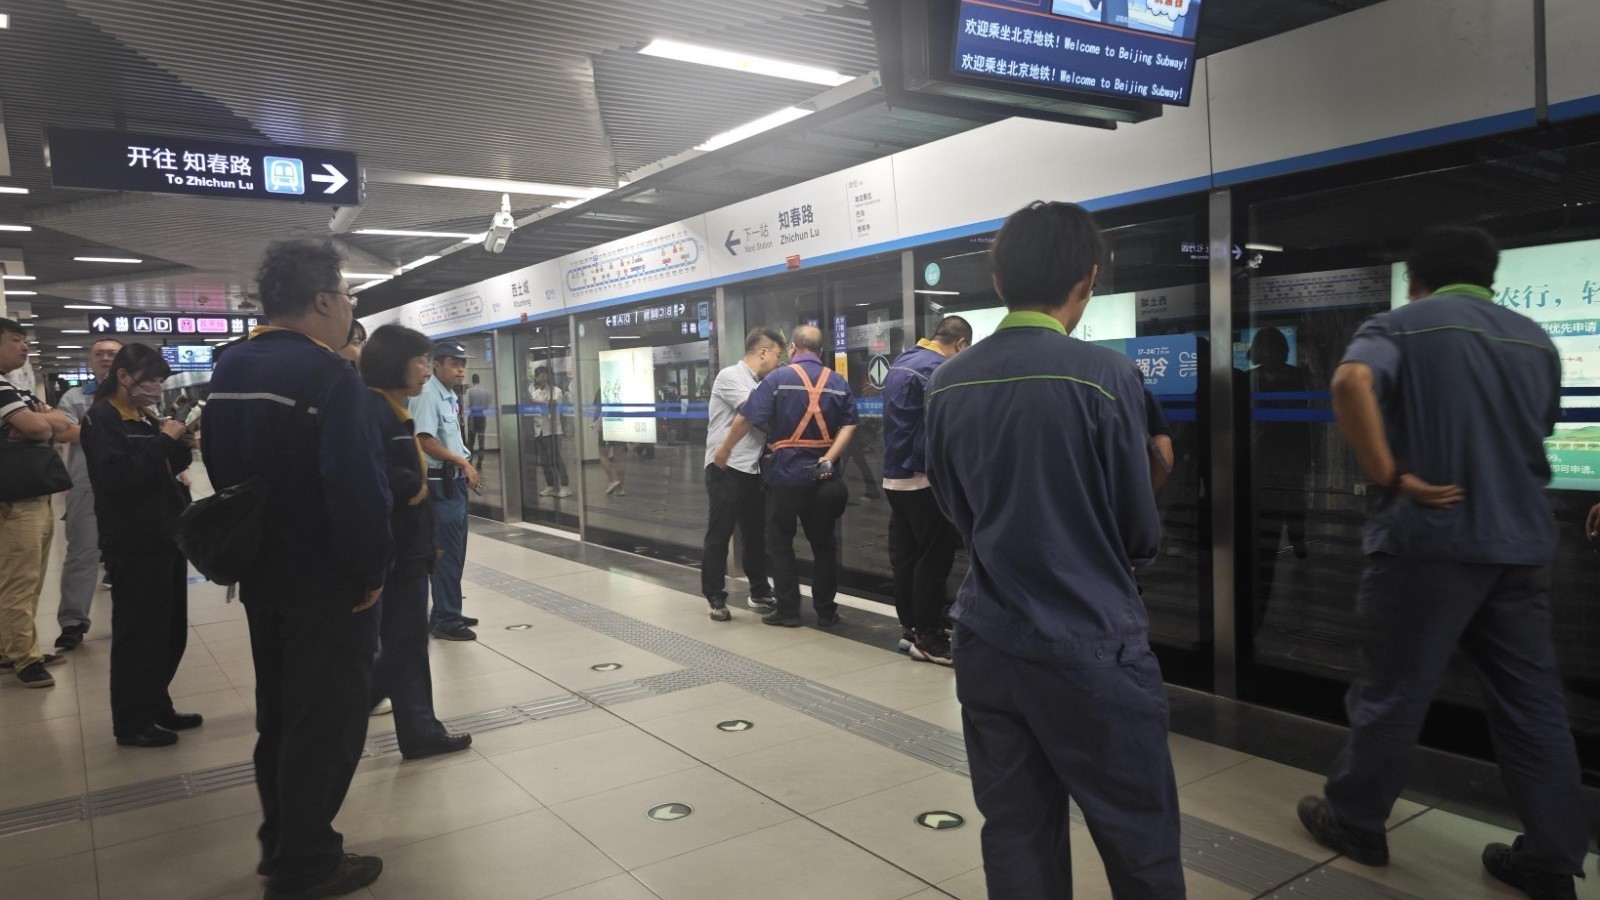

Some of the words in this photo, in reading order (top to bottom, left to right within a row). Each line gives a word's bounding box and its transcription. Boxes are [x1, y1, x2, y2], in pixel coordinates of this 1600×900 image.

[965, 18, 1060, 48] 欢迎乘坐北京地铁！
[1064, 37, 1101, 55] Welcome
[1105, 45, 1115, 57] to
[1118, 47, 1153, 65] Beijing
[1156, 54, 1187, 70] Subway!
[961, 54, 1056, 81] 欢迎乘坐北京地铁！
[1061, 70, 1096, 87] Welcome
[1100, 77, 1110, 89] to
[1114, 78, 1149, 96] Beijing
[1151, 84, 1183, 100] Subway!
[127, 146, 178, 170] 开往
[183, 150, 252, 176] 知春路
[165, 174, 184, 185] To
[186, 175, 236, 189] Zhichun
[238, 180, 254, 190] Lu
[778, 204, 814, 231] 知春路
[743, 222, 770, 242] 下一站
[780, 231, 809, 245] Zhichun
[810, 228, 820, 238] Lu
[1136, 357, 1169, 377] 强冷
